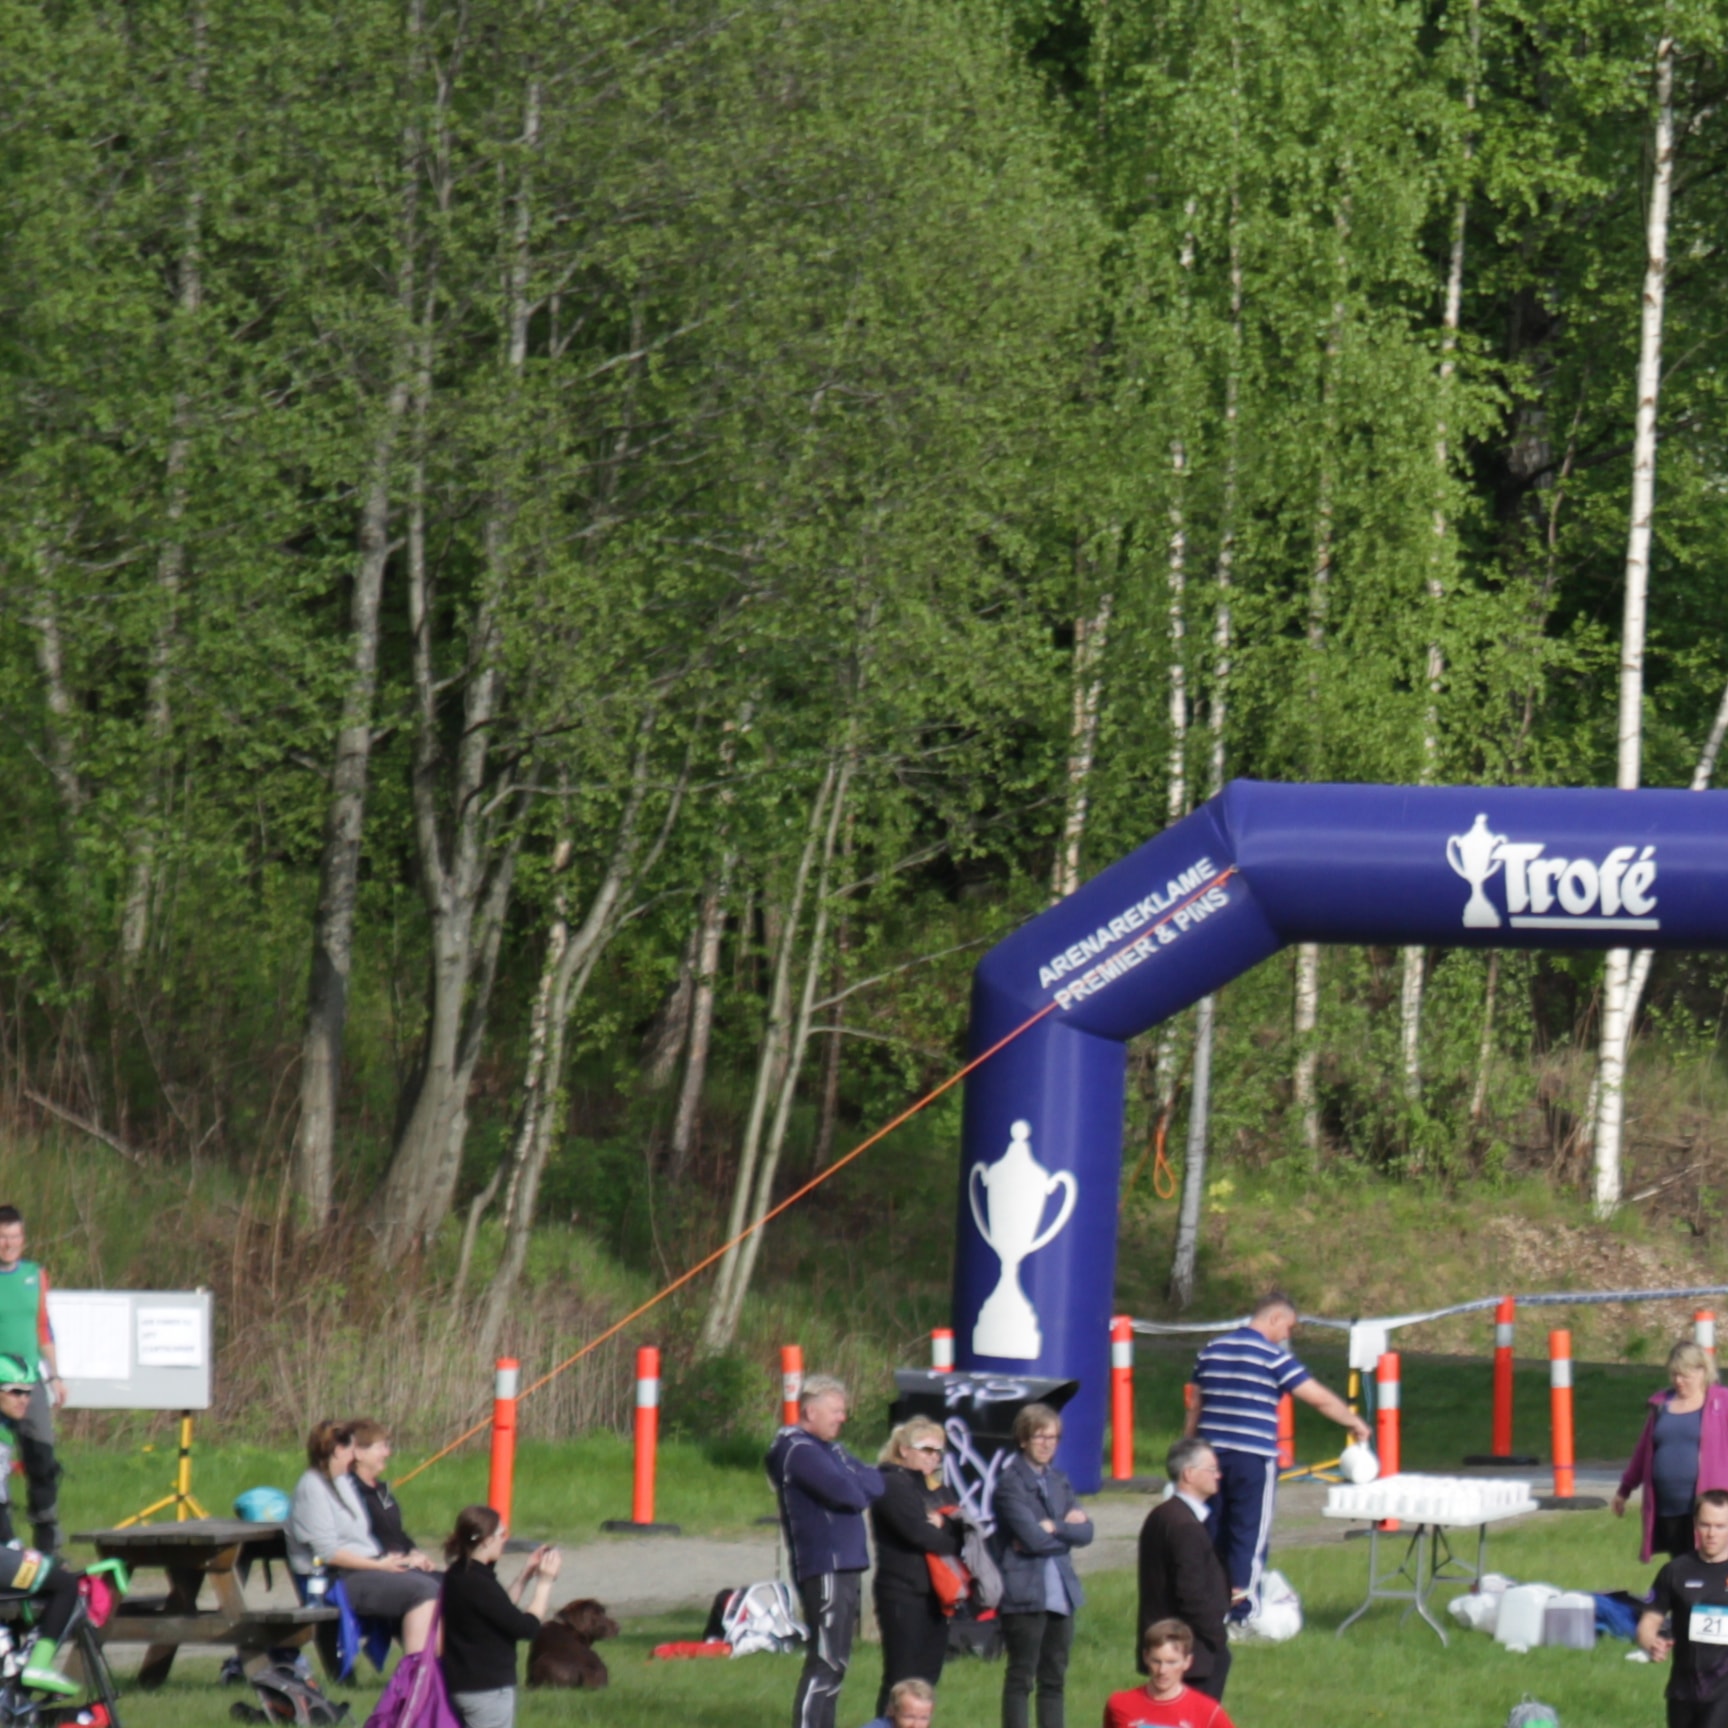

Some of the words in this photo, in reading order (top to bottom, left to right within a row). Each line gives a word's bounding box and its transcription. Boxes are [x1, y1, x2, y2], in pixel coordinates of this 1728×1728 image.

[1038, 856, 1218, 989] ARENAREKLAME
[1491, 842, 1658, 916] Trofé
[1053, 937, 1160, 1011] PREMIER
[1154, 925, 1179, 945] &
[1170, 886, 1230, 933] PINS
[1703, 1617, 1723, 1635] 21
